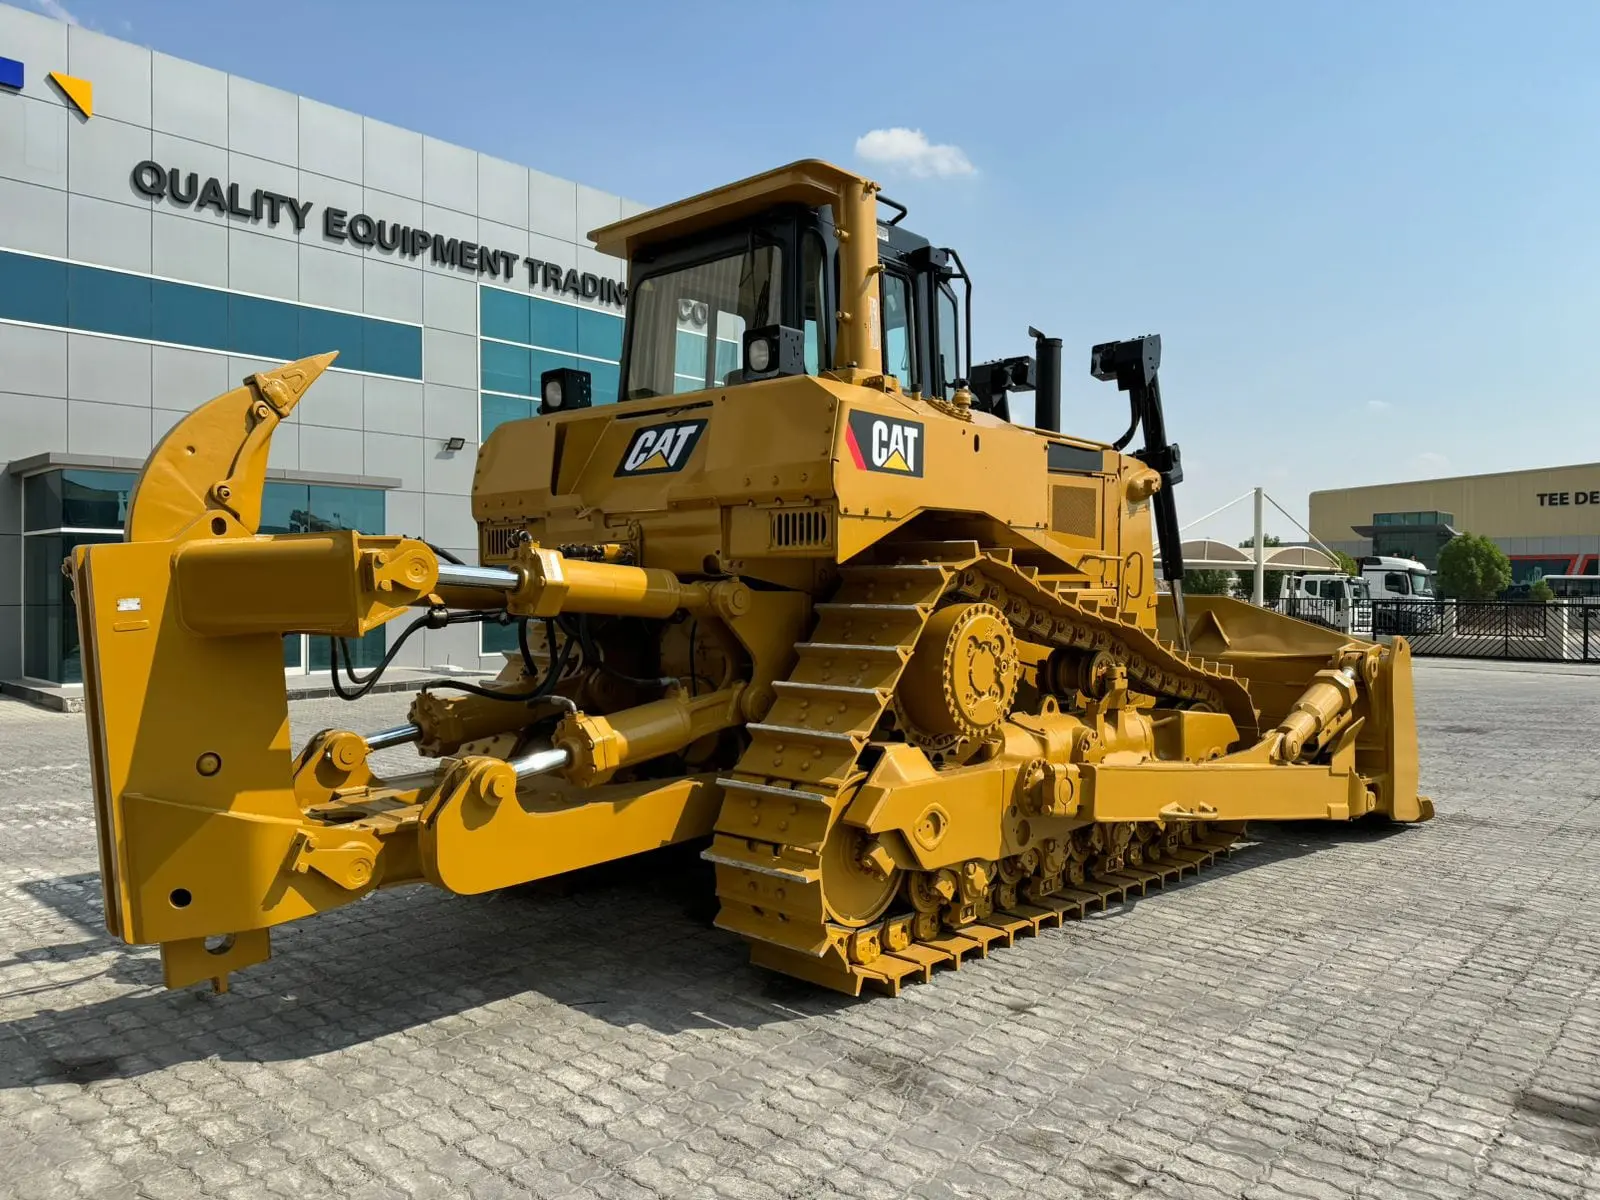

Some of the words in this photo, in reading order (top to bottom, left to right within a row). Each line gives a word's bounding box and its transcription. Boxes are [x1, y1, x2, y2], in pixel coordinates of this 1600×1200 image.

[132, 160, 313, 230] QUALITY
[325, 207, 519, 279] EQUIPMENT
[524, 257, 628, 306] TRADIN
[624, 424, 698, 472] CAT
[872, 420, 918, 472] CAT
[1536, 492, 1569, 506] TEE
